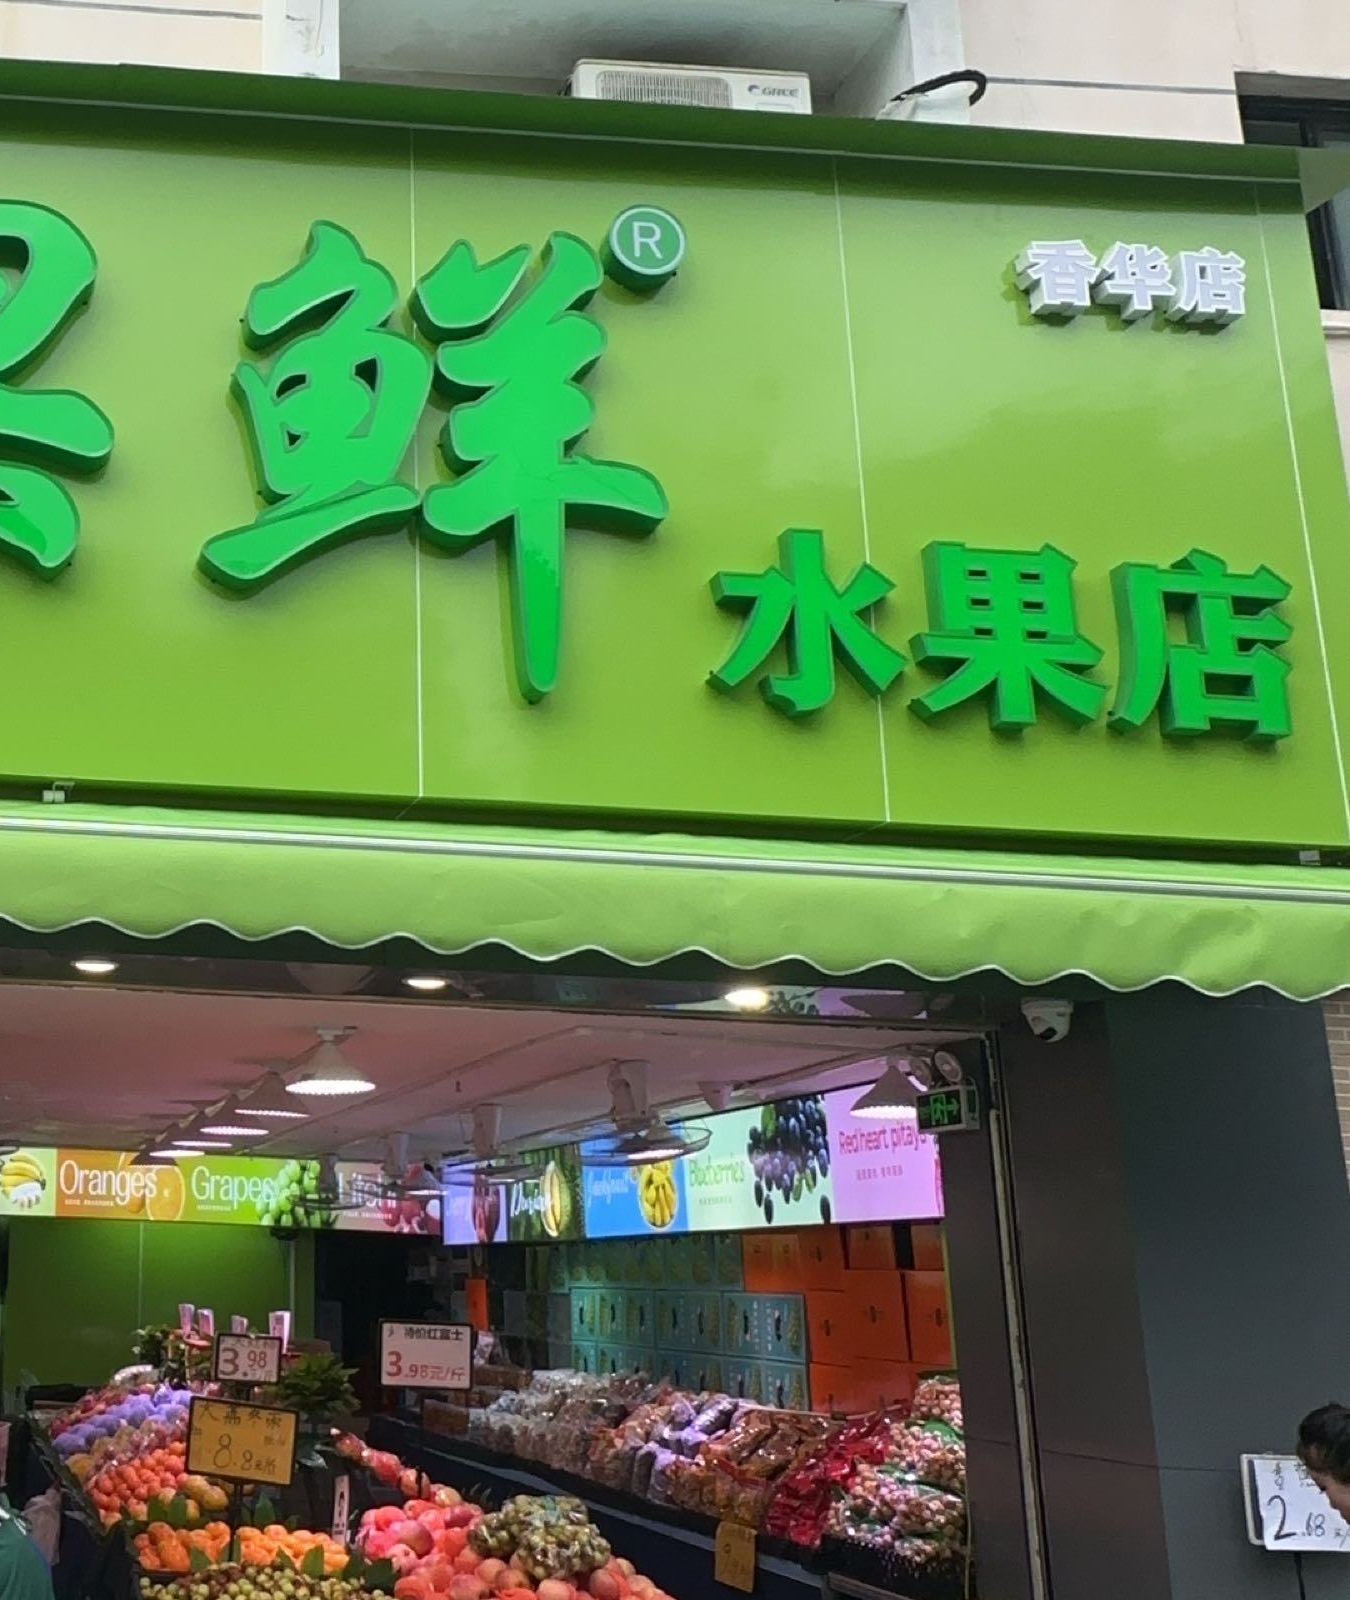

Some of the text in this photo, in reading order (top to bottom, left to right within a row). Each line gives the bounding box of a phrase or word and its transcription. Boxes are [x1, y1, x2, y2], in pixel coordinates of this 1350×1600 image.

[1013, 239, 1247, 326] 香华店
[705, 528, 1294, 738] 水果店
[59, 1159, 158, 1206] Oranges
[191, 1165, 277, 1211] Grapes
[386, 1350, 466, 1381] 3.98元/斤
